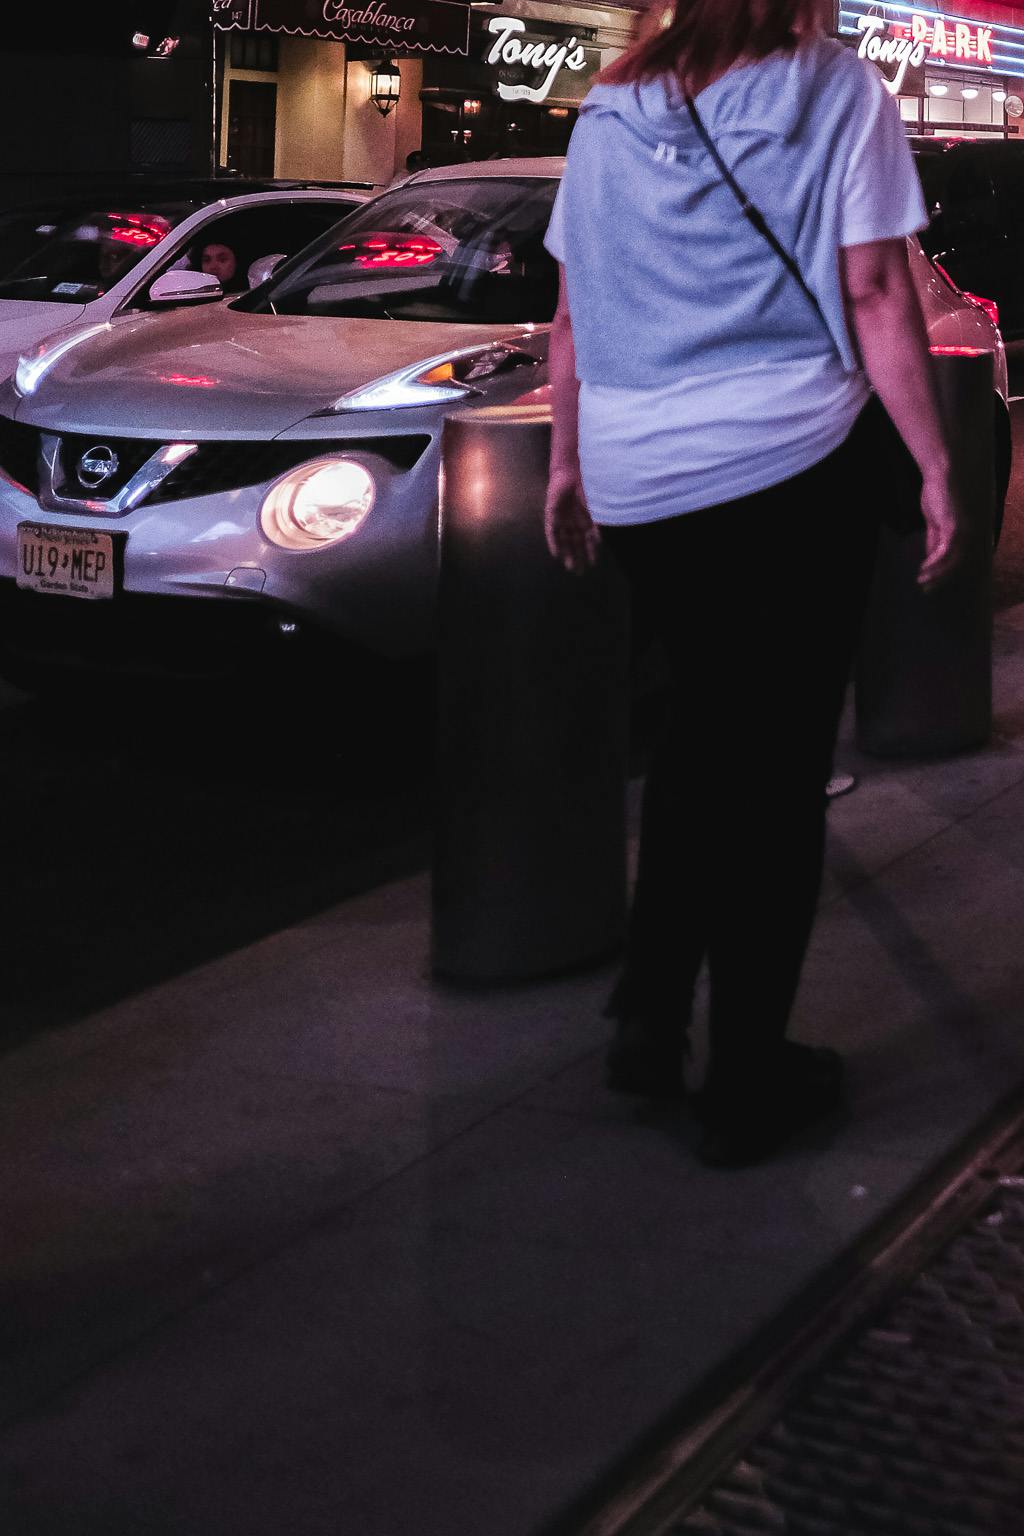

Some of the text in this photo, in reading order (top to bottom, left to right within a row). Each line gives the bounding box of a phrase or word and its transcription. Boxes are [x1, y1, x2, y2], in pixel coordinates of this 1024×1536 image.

[488, 17, 588, 103] Tony's
[857, 15, 926, 95] Tony's
[911, 14, 993, 62] PARK
